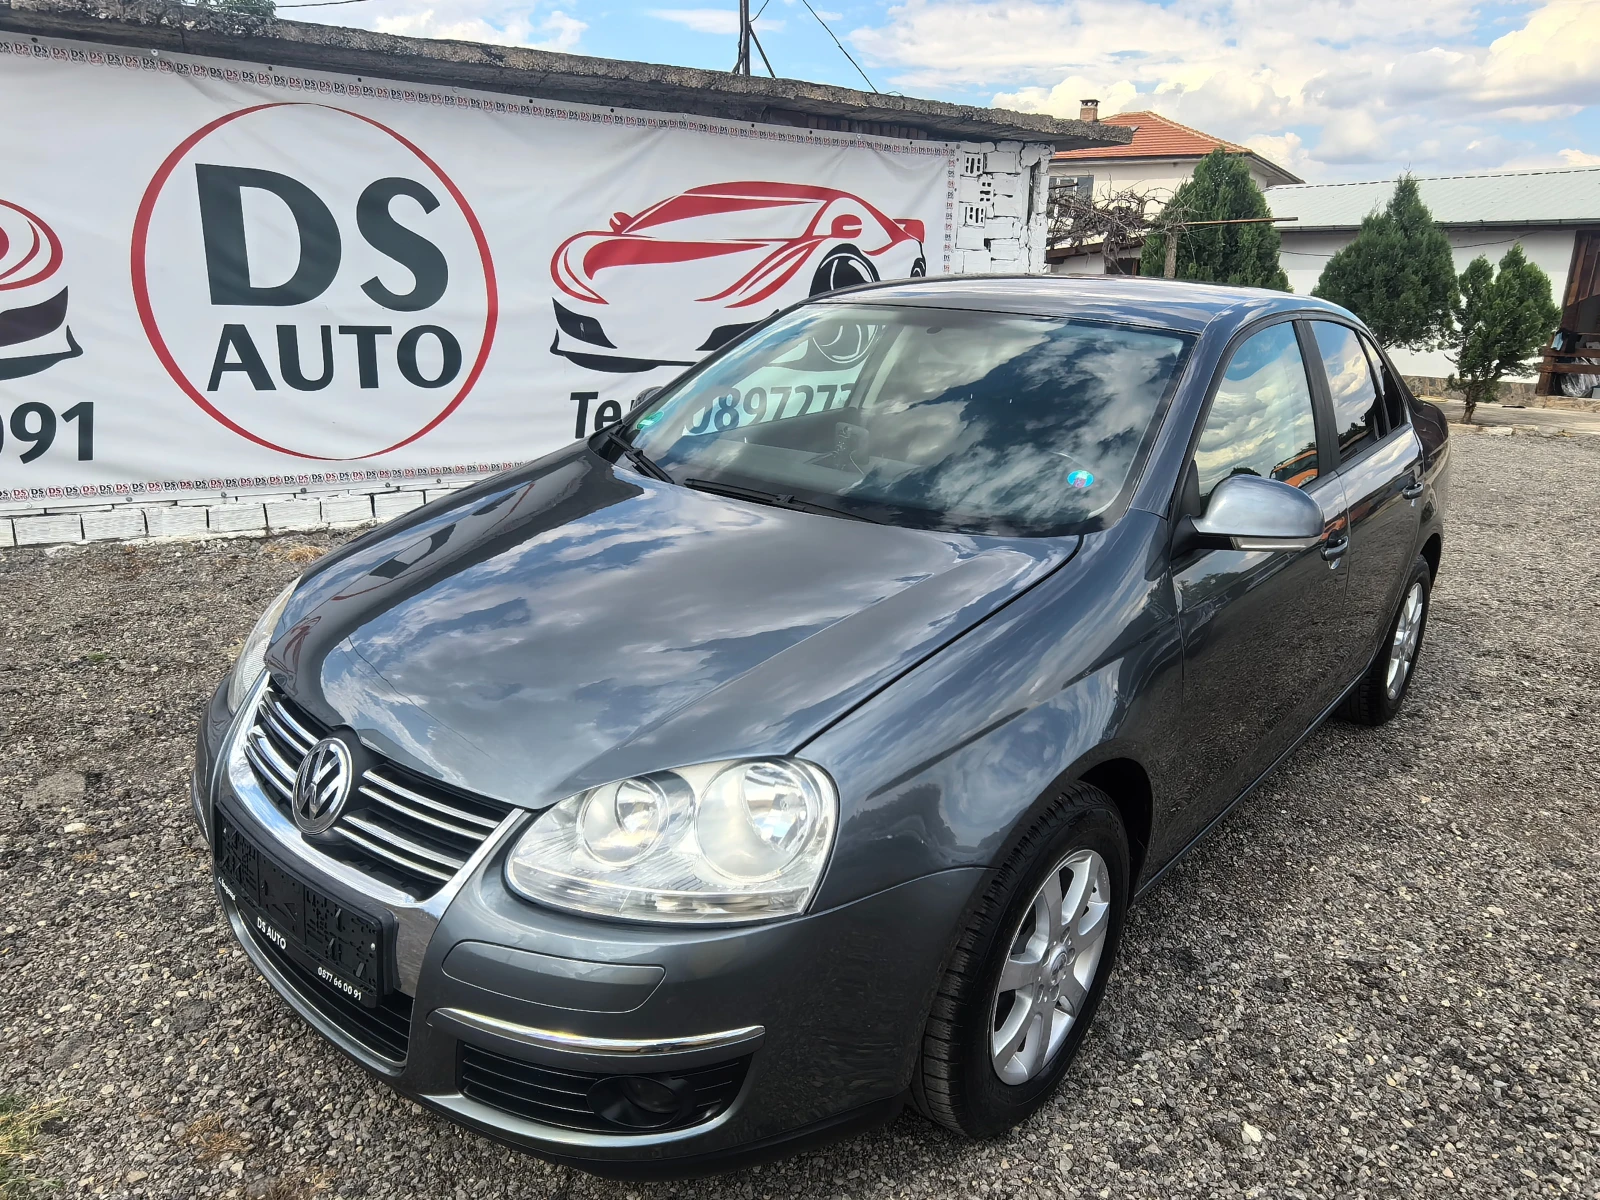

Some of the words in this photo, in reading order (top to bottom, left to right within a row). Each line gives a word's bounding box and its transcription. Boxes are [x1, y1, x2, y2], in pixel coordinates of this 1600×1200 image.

[53, 48, 66, 56] DS
[71, 49, 84, 57] DS
[90, 51, 102, 59] DS
[108, 54, 120, 62] DS
[125, 56, 138, 64] DS
[210, 68, 222, 76] DS
[195, 163, 448, 312] DS
[206, 324, 462, 391] AUTO
[0, 402, 94, 464] 91
[257, 917, 266, 933] DS
[266, 926, 286, 950] AUTO
[343, 983, 352, 994] 00
[354, 990, 361, 1000] 91
